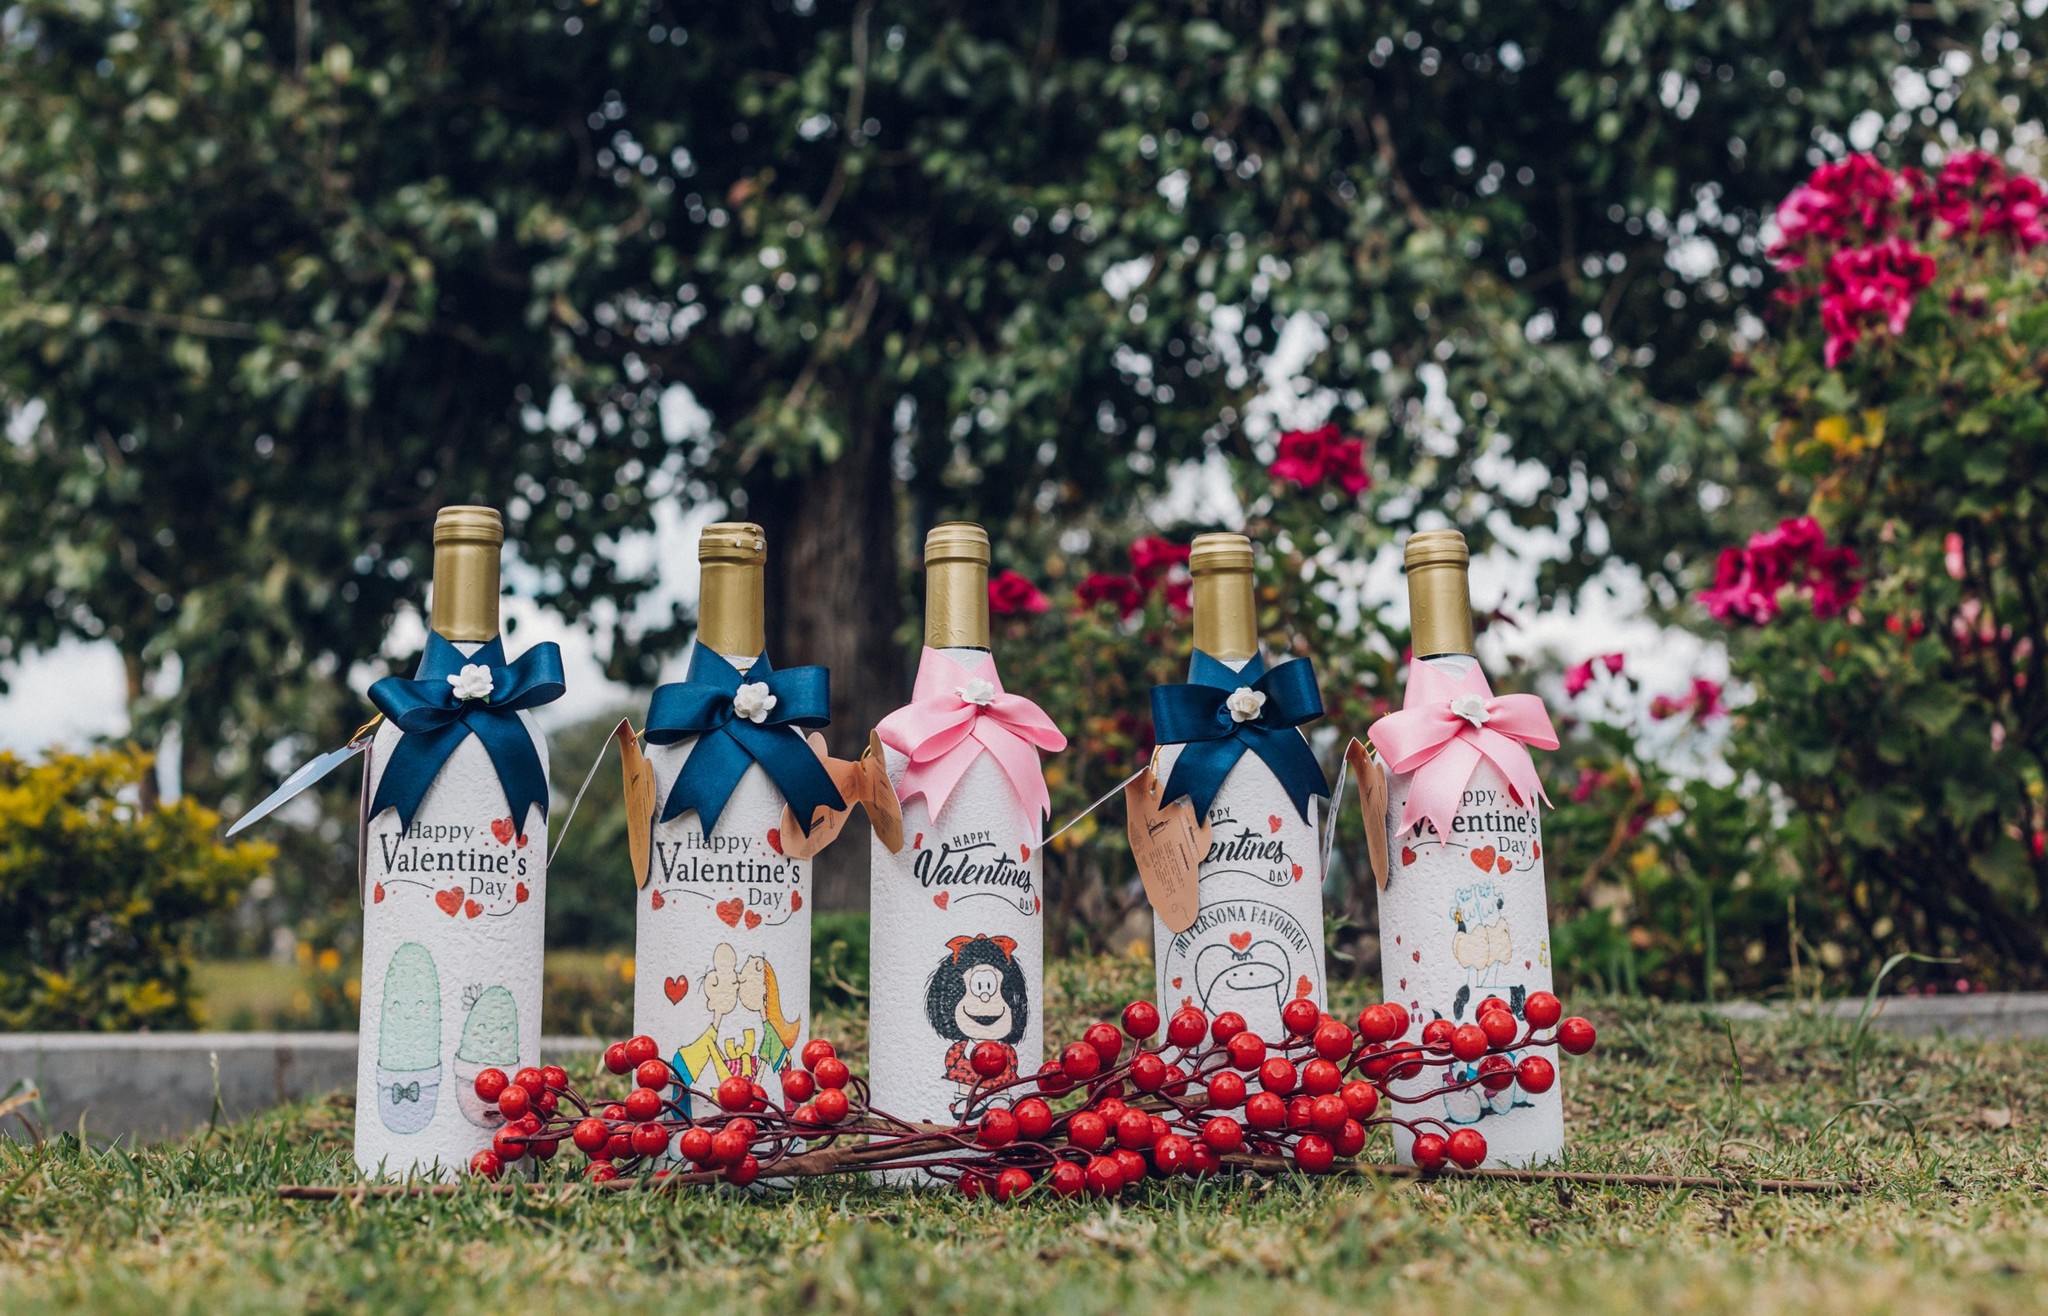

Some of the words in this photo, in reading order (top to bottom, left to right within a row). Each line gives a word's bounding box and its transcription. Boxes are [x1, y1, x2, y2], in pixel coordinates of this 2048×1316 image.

[1461, 788, 1498, 807] ppy
[1209, 806, 1231, 822] PPY
[1411, 809, 1538, 838] Vaentine's
[408, 820, 476, 844] Happy
[686, 831, 753, 854] Happy
[952, 830, 991, 848] HAPPY
[380, 832, 528, 876] Valentine's
[1204, 826, 1284, 865] entines
[1497, 836, 1528, 856] Day
[655, 841, 801, 884] Valentine's
[913, 843, 1031, 894] Valentines
[1268, 868, 1289, 883] DAY
[468, 876, 508, 900] Day
[747, 887, 784, 910] Day
[1019, 897, 1033, 911] DAY
[1187, 905, 1247, 940] PERSONA
[1251, 905, 1308, 955] FAVORITA!
